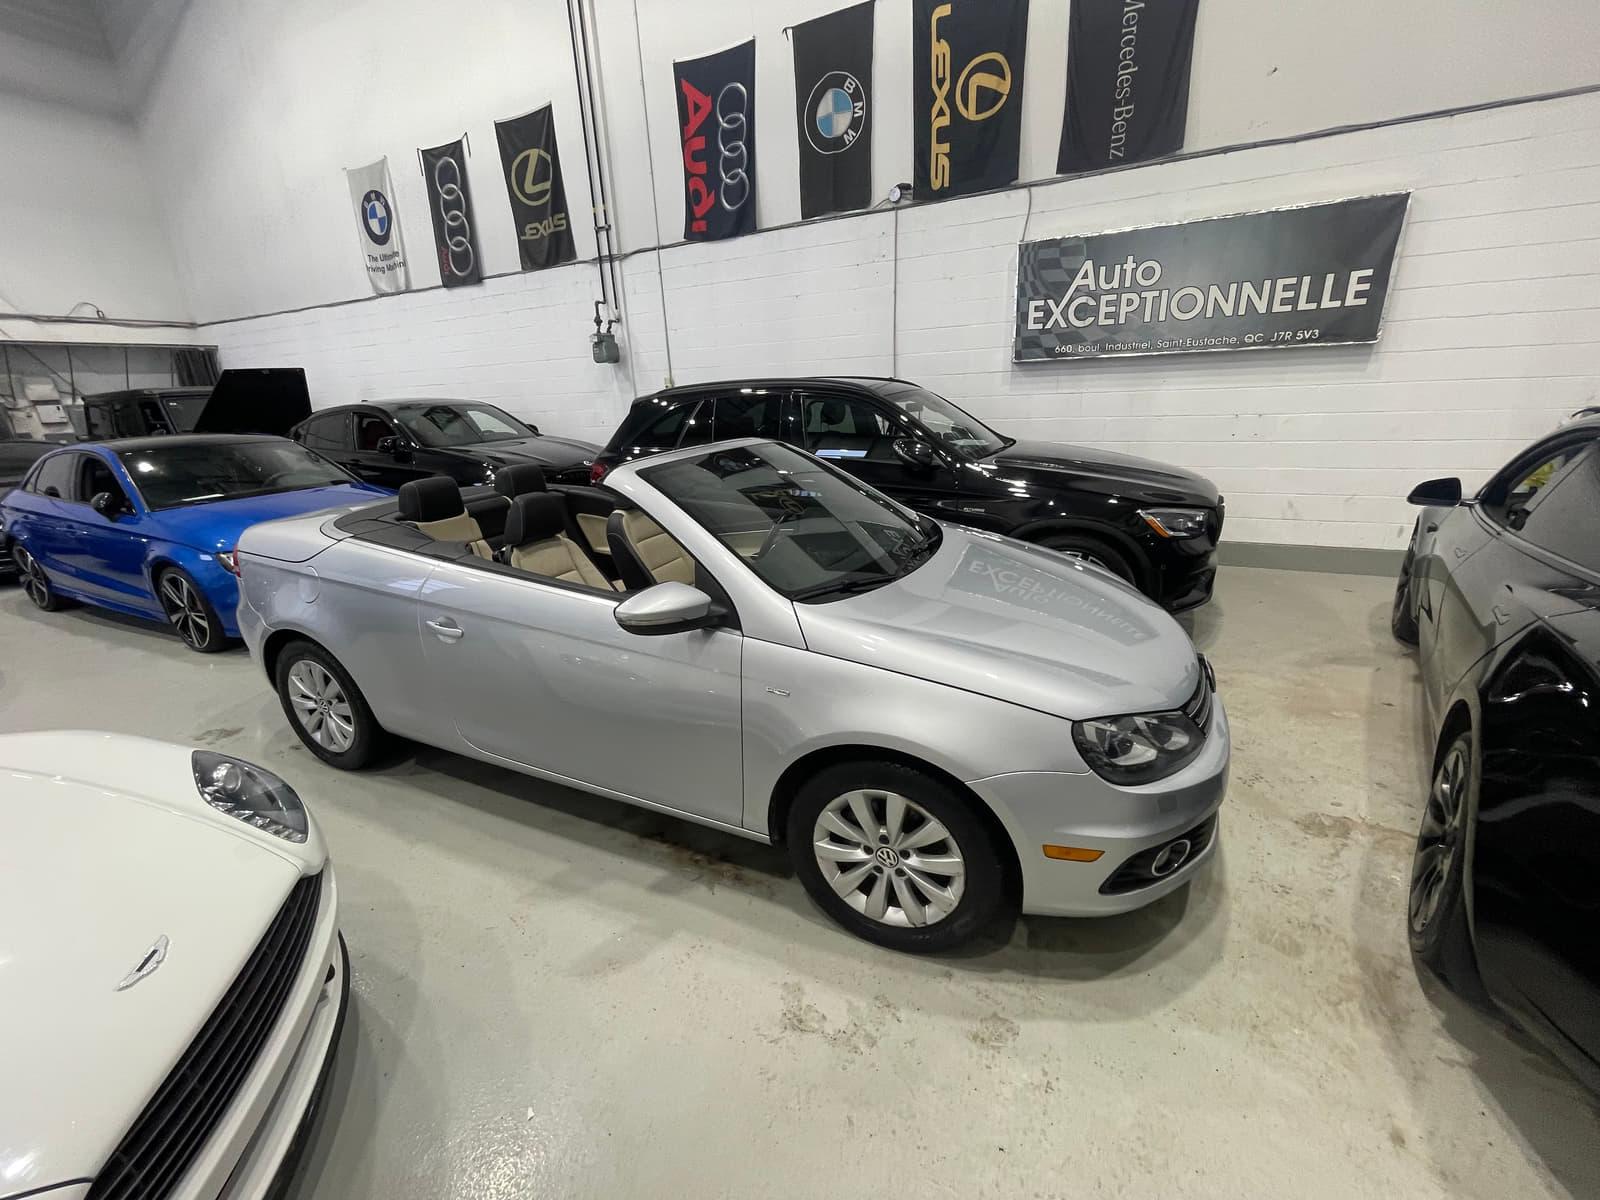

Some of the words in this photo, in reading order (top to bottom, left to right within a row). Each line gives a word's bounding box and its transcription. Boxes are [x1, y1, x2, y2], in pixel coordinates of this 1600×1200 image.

[843, 77, 863, 145] BMW
[930, 4, 951, 191] LEXUS
[1027, 268, 1374, 330] EXCEPTIONNELLE
[1068, 255, 1162, 292] Auto
[1244, 333, 1265, 344] QC
[1270, 331, 1293, 342] J7R
[1295, 329, 1320, 341] 5V3
